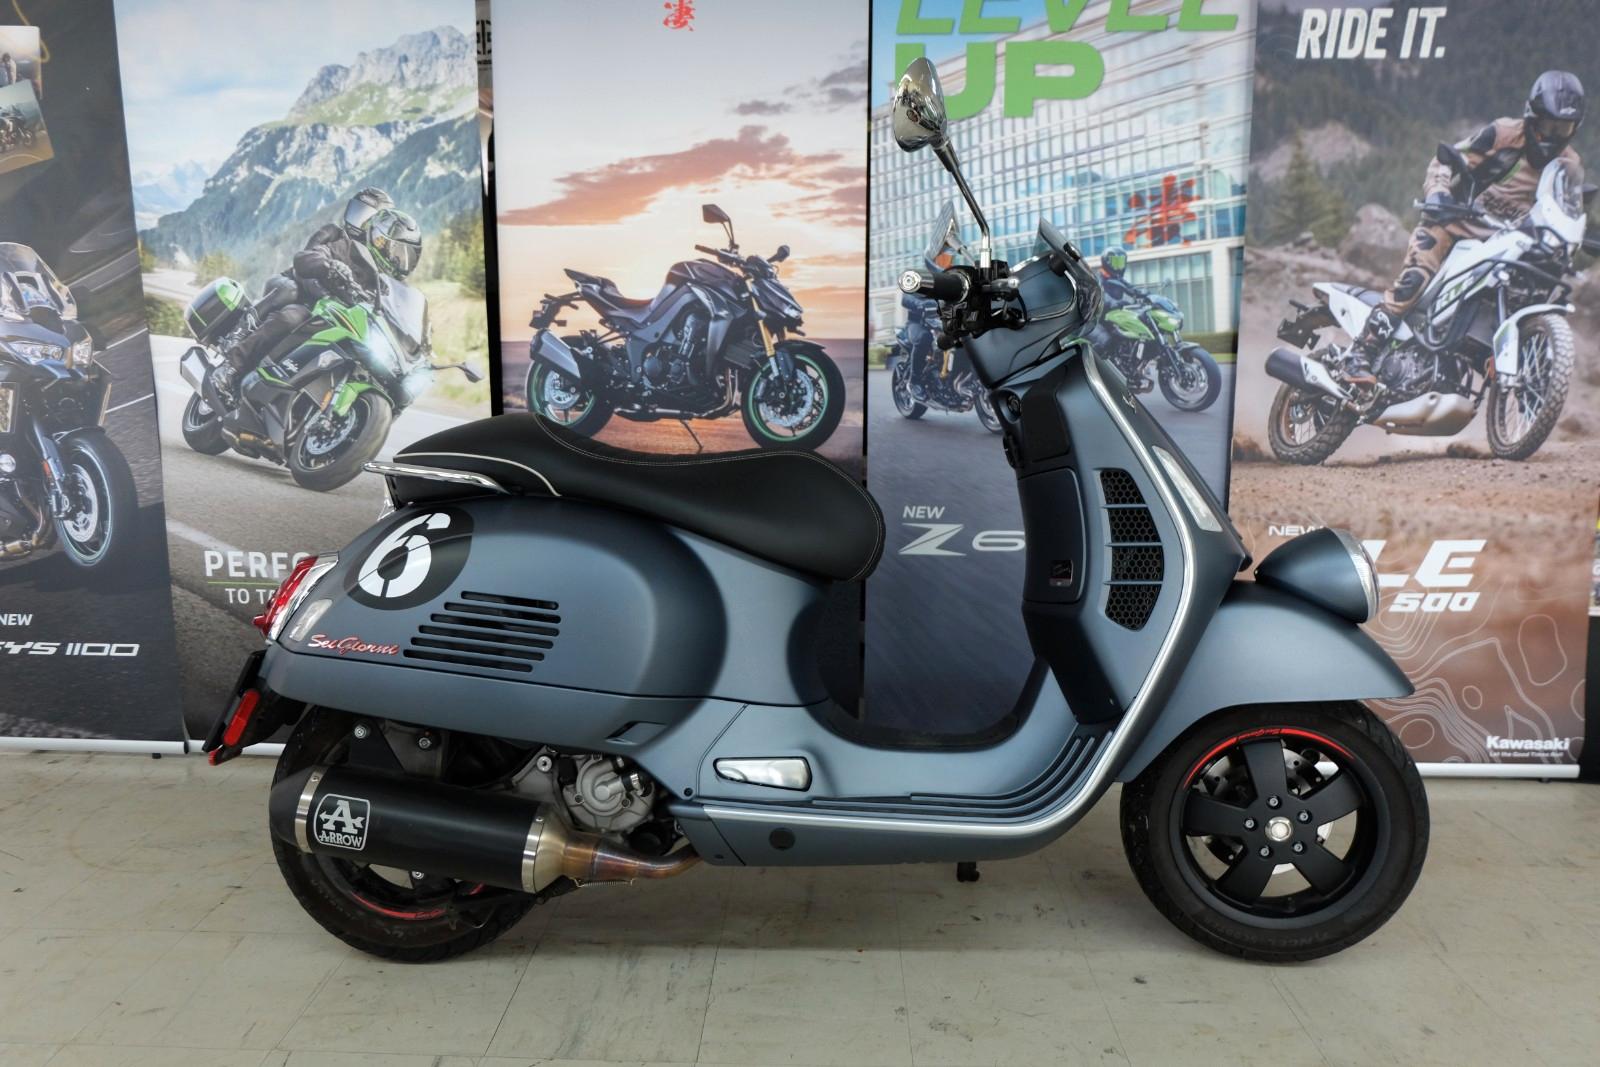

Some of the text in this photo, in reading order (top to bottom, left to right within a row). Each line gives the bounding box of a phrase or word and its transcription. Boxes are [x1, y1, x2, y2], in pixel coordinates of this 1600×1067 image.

[1296, 7, 1447, 59] RIDE IT.
[894, 41, 1104, 120] UP
[902, 505, 945, 519] NEW
[358, 512, 451, 598] 6
[225, 588, 250, 604] TO
[1388, 592, 1480, 613] 500
[0, 613, 33, 626] NEW
[0, 641, 140, 657] YS 1100
[1486, 735, 1570, 751] Kawasaki
[319, 830, 363, 848] ARROW
